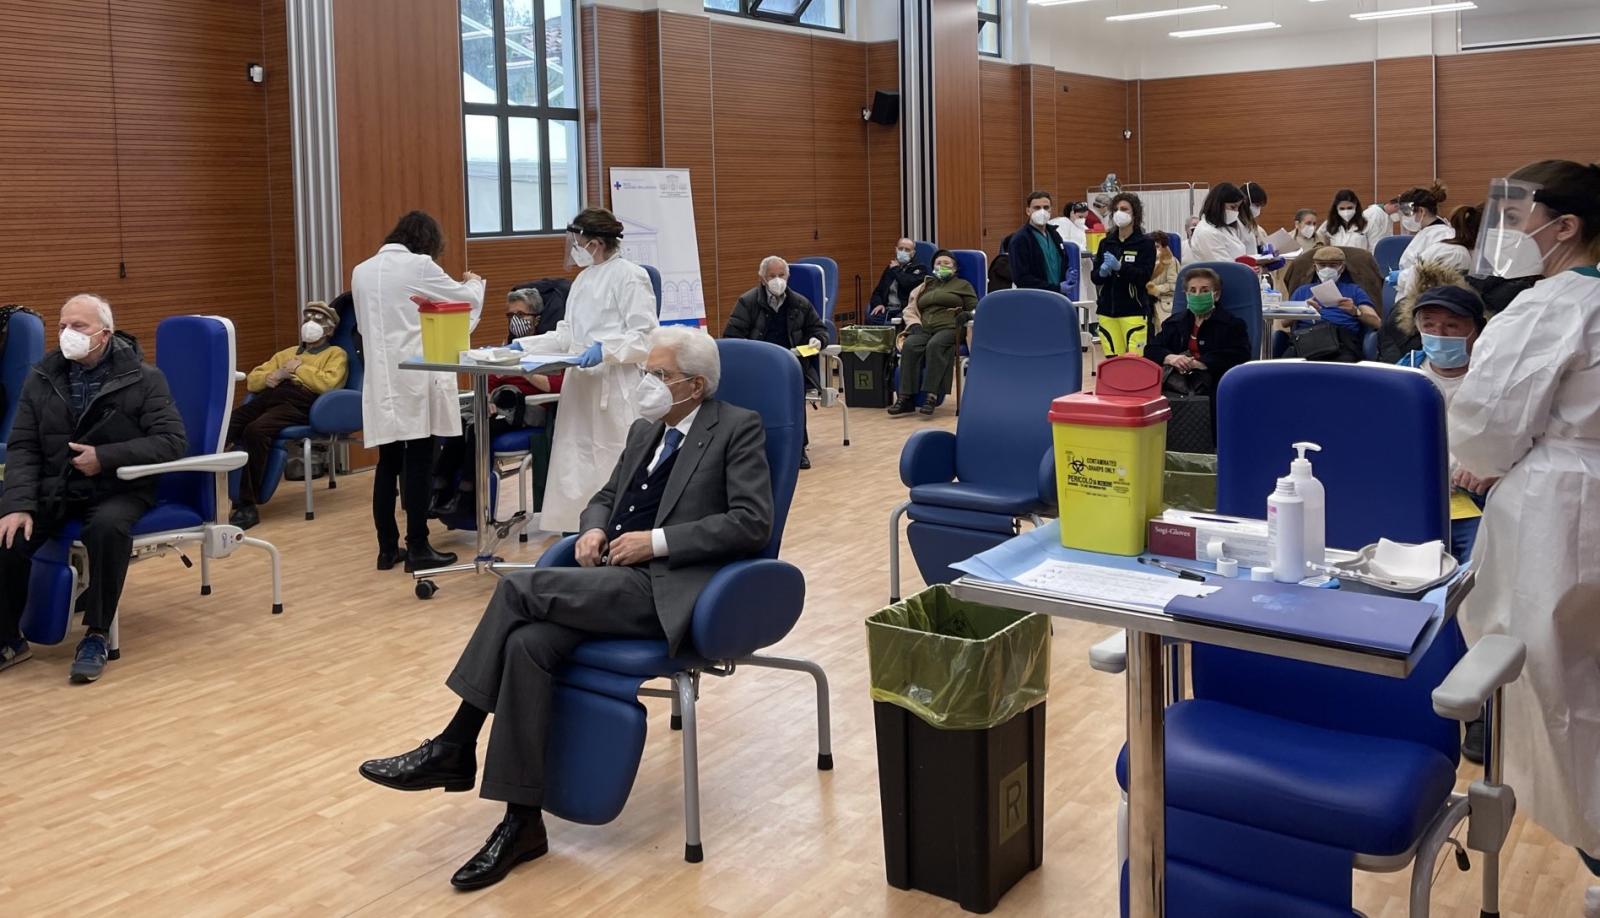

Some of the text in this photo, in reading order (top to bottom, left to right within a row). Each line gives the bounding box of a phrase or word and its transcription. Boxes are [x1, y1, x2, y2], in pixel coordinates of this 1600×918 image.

[859, 374, 869, 387] R
[1086, 457, 1117, 467] CONTAMINATED
[1088, 465, 1104, 473] SHARPS
[1067, 474, 1093, 485] PERICOLO
[1006, 780, 1021, 828] R
